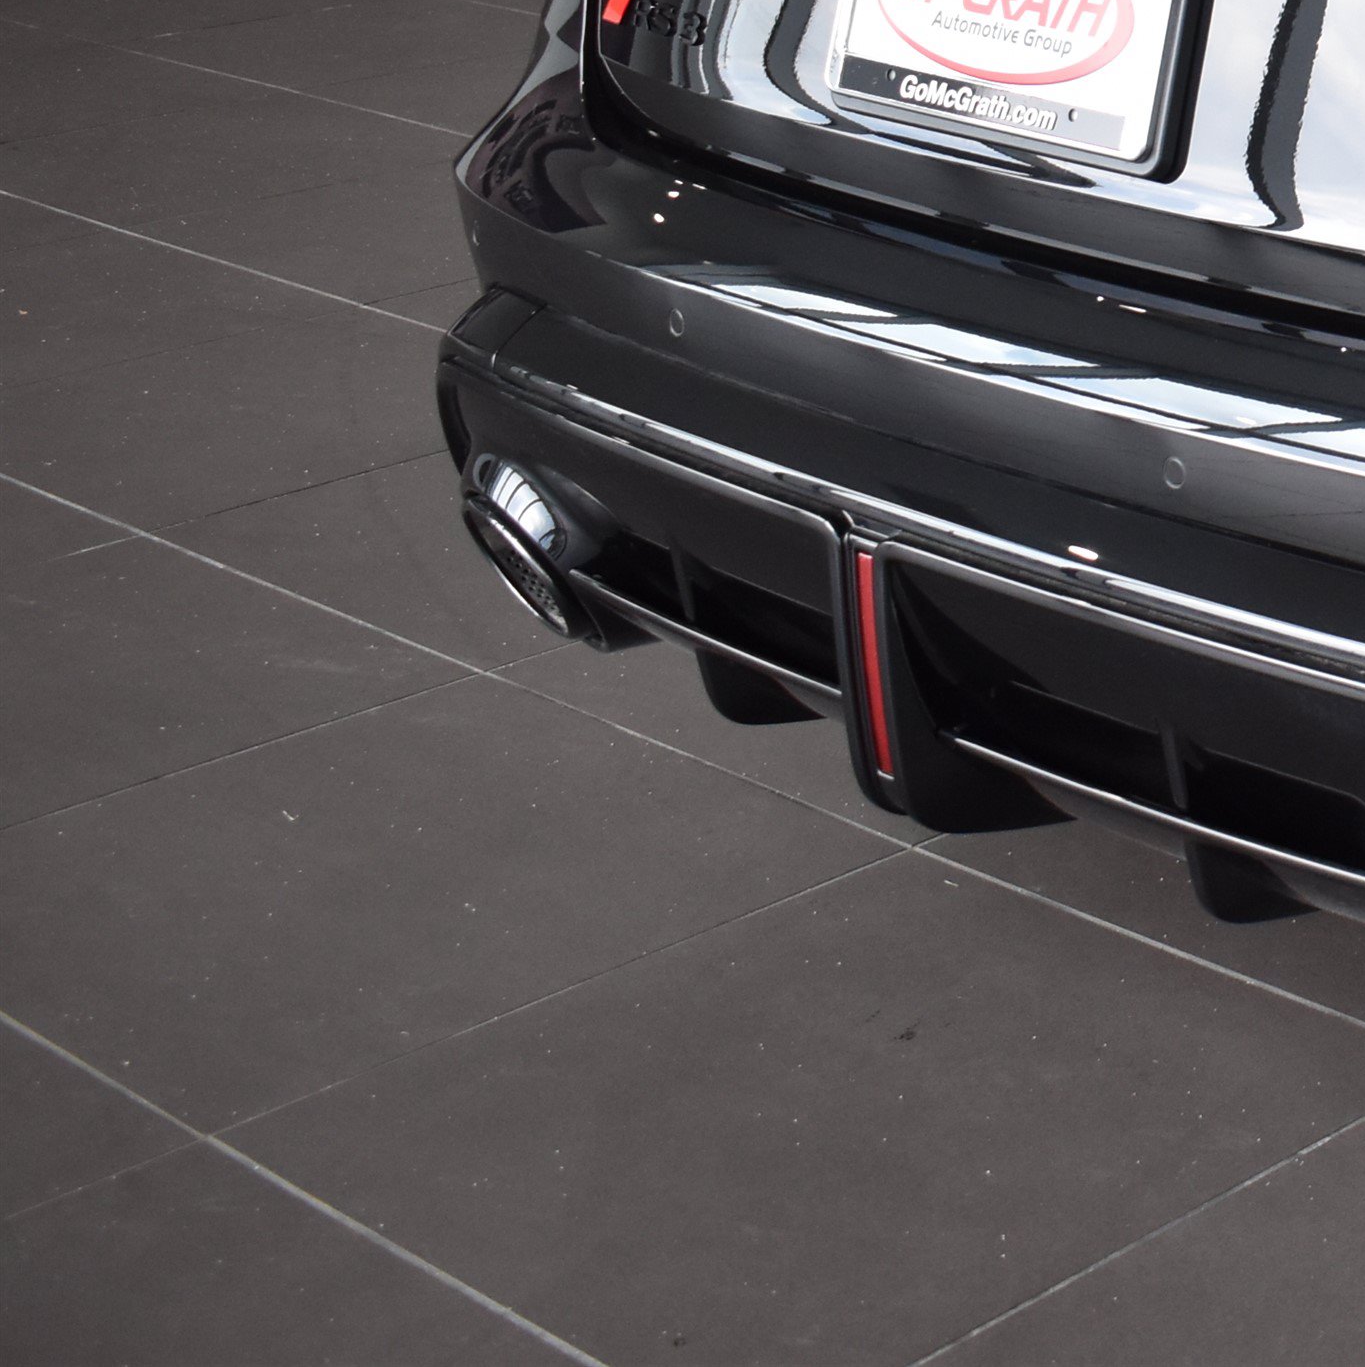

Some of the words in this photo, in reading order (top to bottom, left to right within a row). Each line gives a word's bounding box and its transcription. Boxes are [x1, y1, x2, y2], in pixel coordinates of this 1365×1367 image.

[931, 10, 1020, 45] Automotive
[1023, 28, 1073, 58] Group
[899, 74, 1059, 131] GoMcGrath.com
